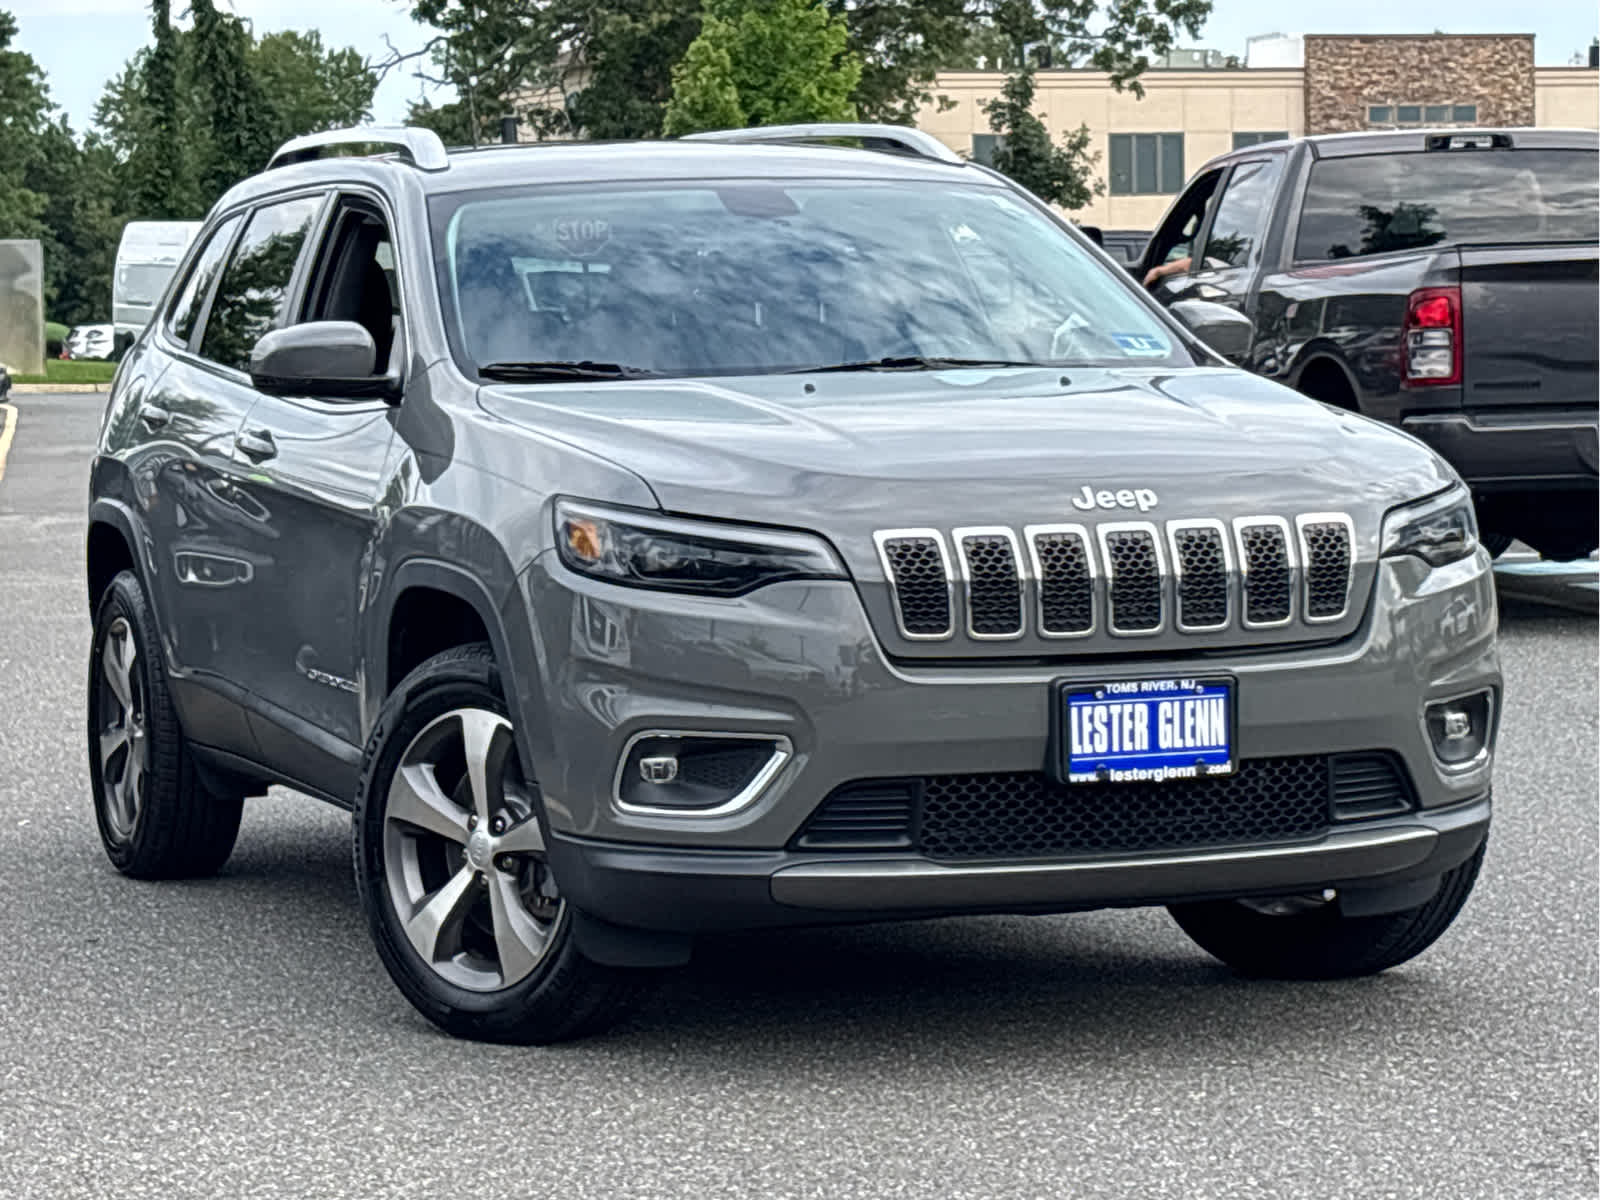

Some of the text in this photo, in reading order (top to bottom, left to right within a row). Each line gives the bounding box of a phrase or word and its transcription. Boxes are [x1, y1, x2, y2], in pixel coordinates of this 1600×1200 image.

[558, 219, 609, 241] STOP
[1072, 485, 1158, 512] Jeep
[1106, 682, 1138, 694] TOMS
[1181, 679, 1196, 690] NJ
[1071, 698, 1225, 755] LESTER GLENN
[1110, 766, 1197, 782] lesterglenn
